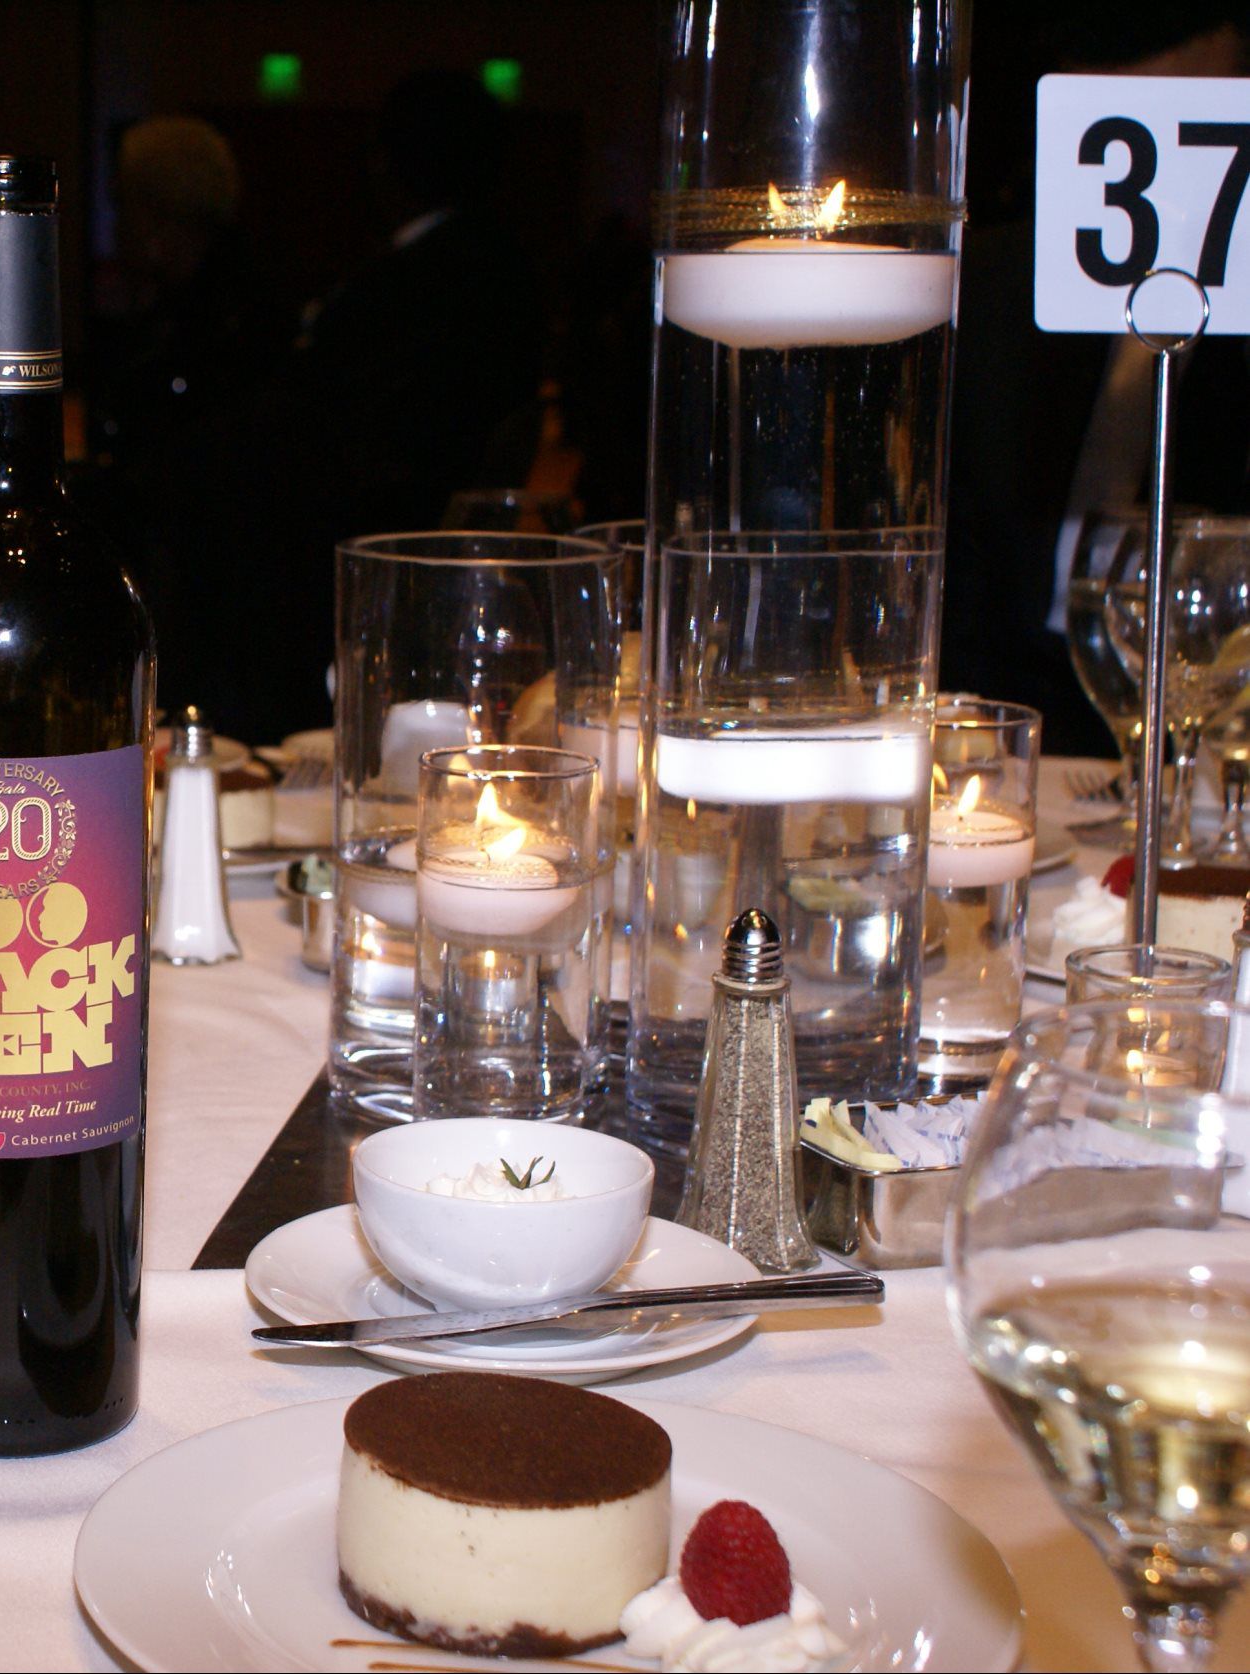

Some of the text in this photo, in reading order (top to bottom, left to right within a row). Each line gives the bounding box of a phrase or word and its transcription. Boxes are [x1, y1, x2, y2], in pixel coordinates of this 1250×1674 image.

[1075, 116, 1250, 287] 37
[29, 1101, 62, 1118] Real
[64, 1100, 97, 1114] Time
[11, 1115, 135, 1146] Cabernet Sauvignon
